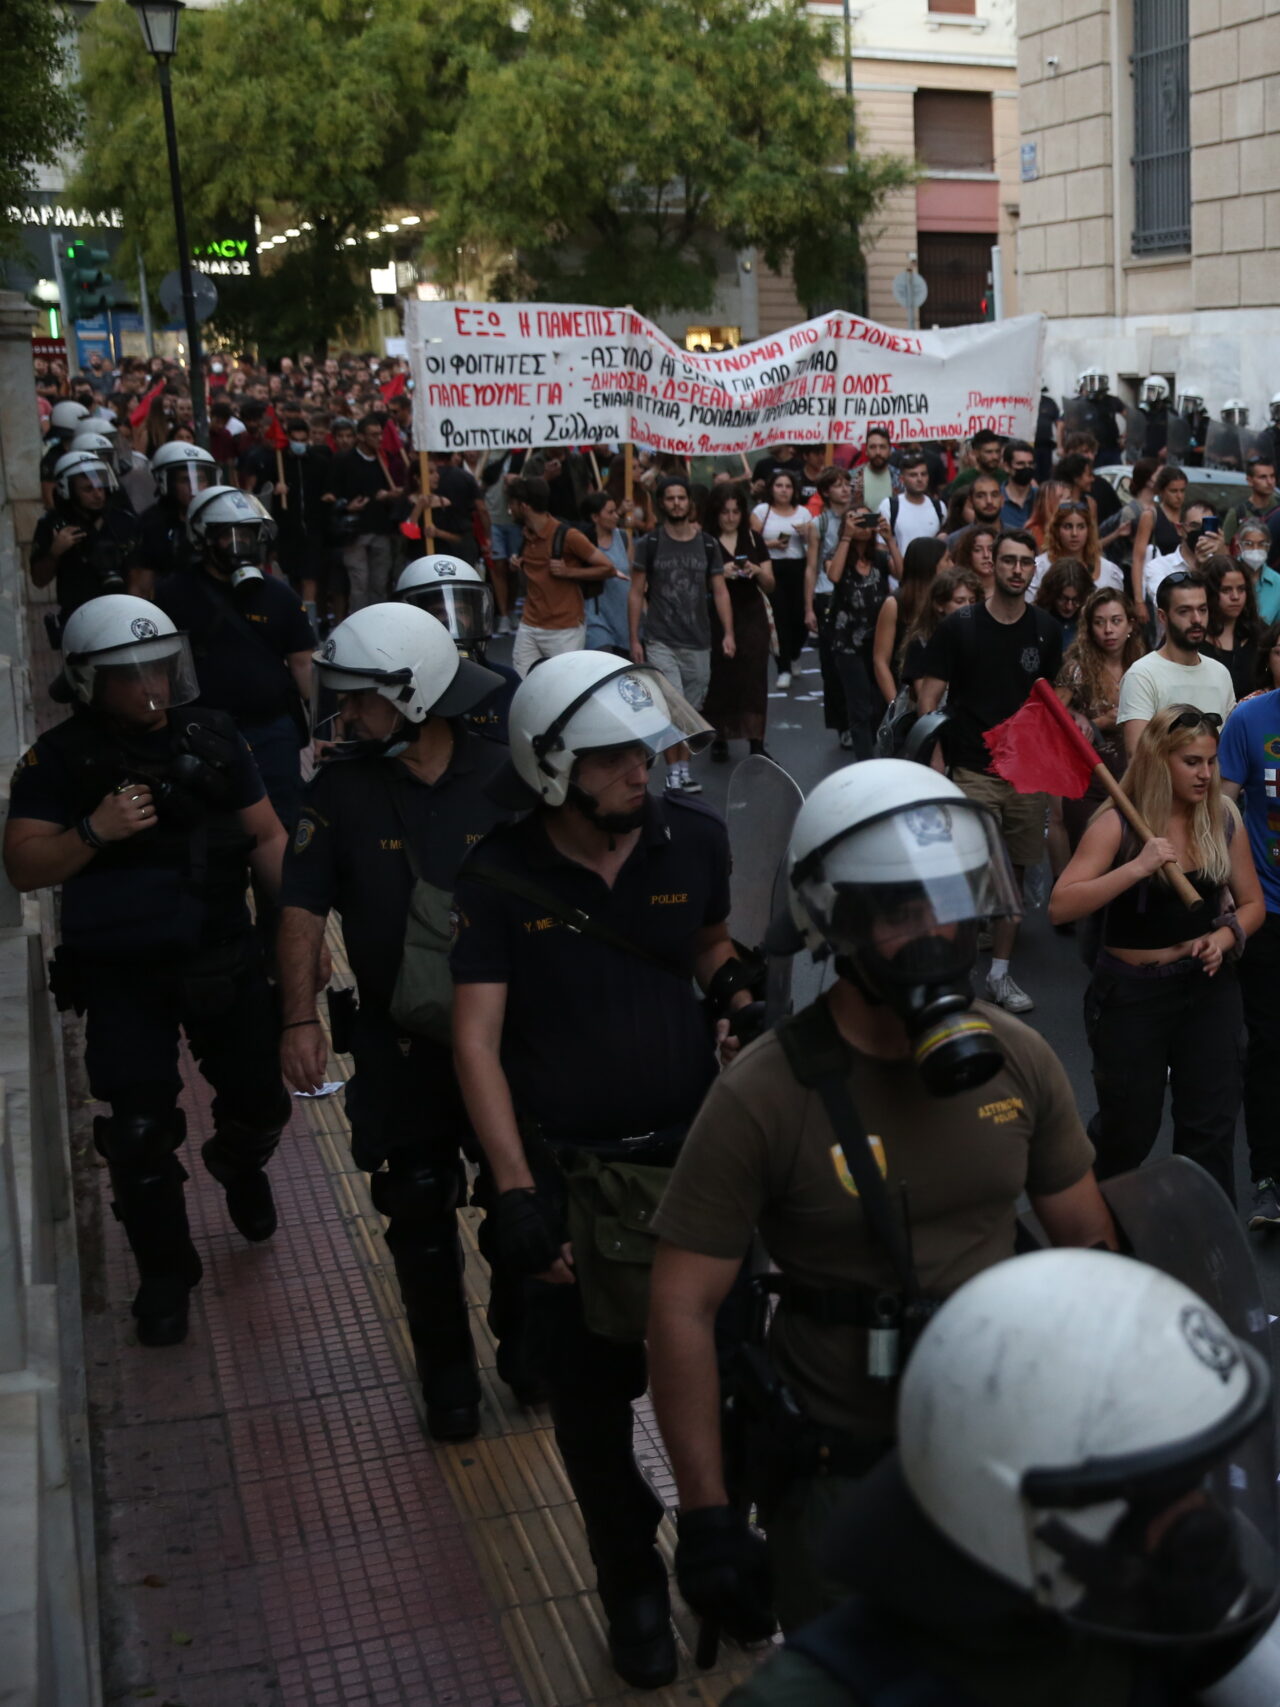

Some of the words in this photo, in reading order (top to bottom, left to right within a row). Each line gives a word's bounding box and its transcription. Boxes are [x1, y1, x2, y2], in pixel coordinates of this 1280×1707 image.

[454, 307, 506, 337] ΕΞΩ
[518, 311, 531, 338] Η
[789, 328, 819, 351] ΑΠΟ
[426, 356, 445, 374] ΟΙ
[450, 353, 547, 375] ΦΟΙΤΗΤΕΣ
[428, 382, 532, 407] ΠΑΛΕΥΟΥΜΕ
[732, 376, 755, 392] ΓΙΑ
[843, 373, 893, 395] ΟΛΟΥΣ
[844, 397, 866, 416] ΓΙΑ
[870, 393, 929, 416] ΔΟΥΛΕΙΑ
[650, 893, 688, 905] POLICE
